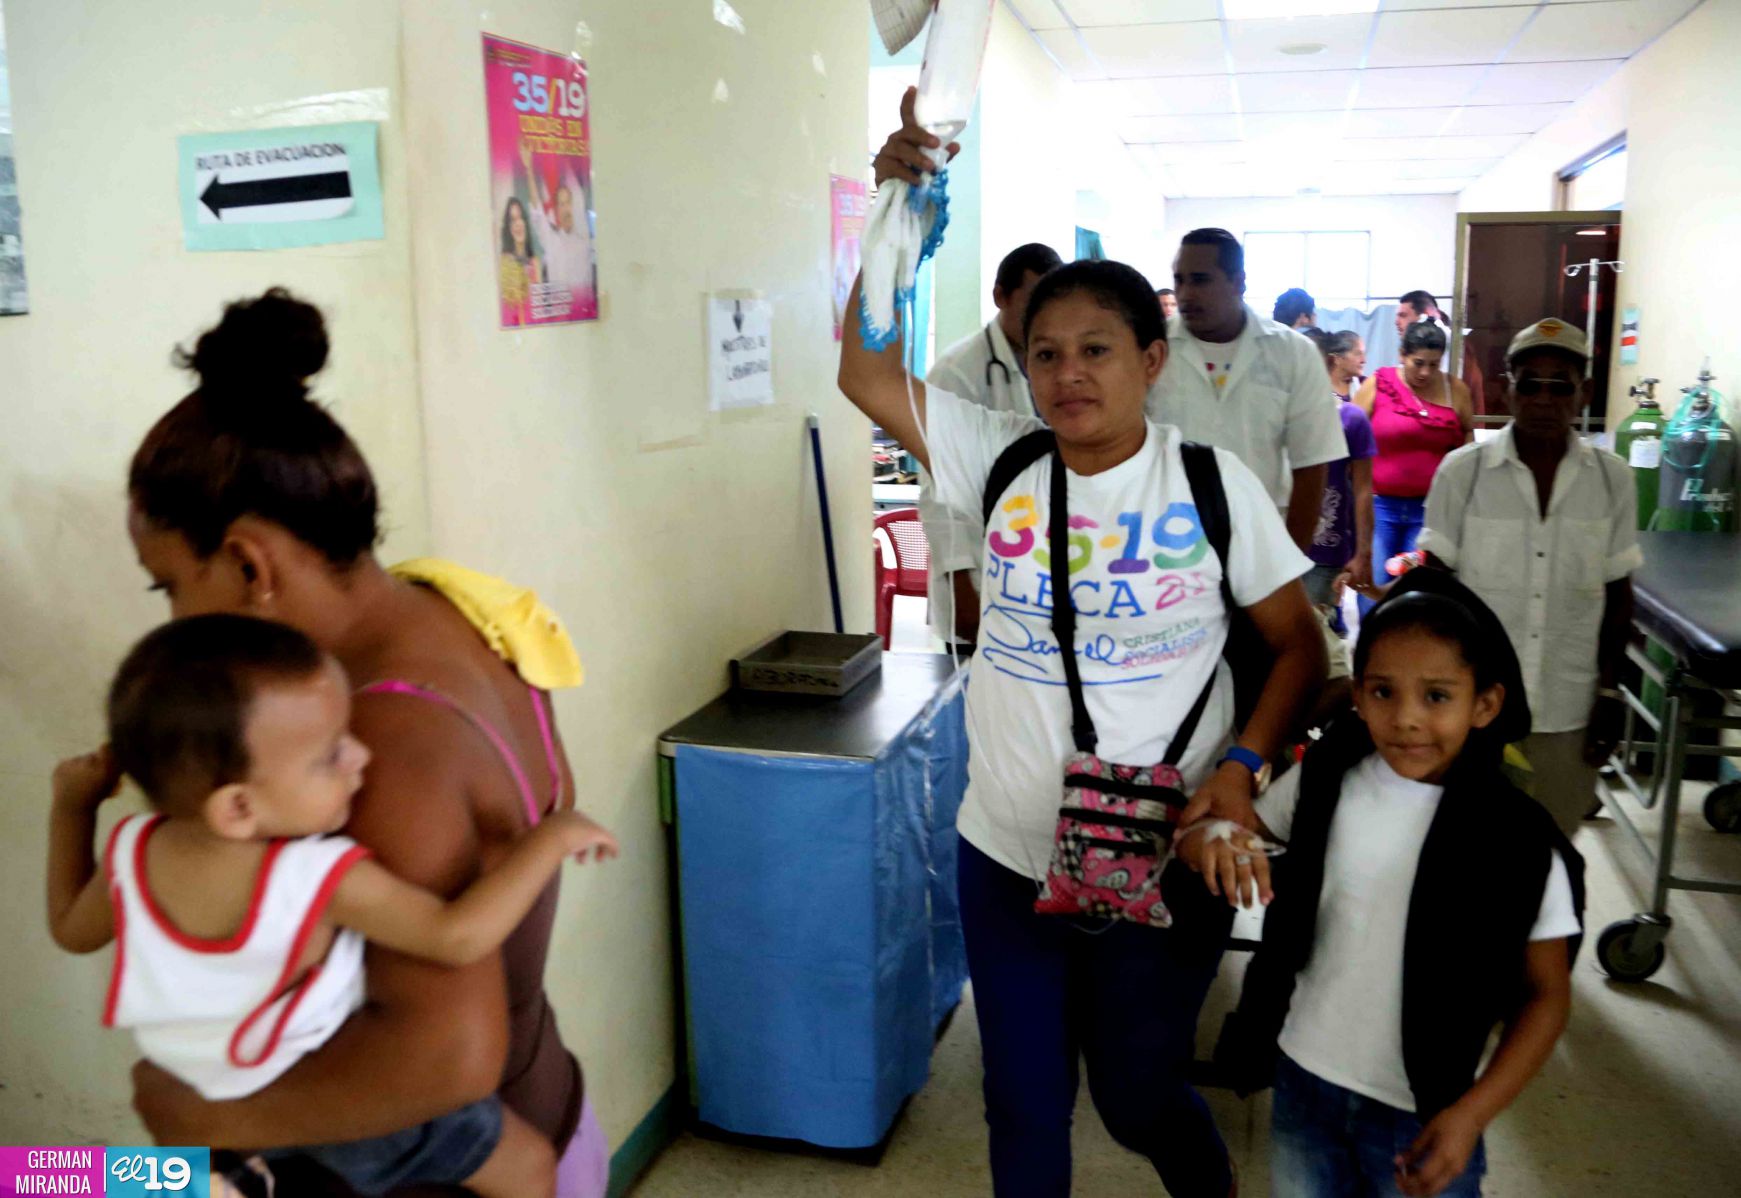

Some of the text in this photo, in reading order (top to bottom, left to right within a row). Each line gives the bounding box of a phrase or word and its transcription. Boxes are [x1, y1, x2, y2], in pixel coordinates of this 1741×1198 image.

[512, 71, 586, 118] 35/19
[197, 142, 347, 170] RUTA DE EVACUACION
